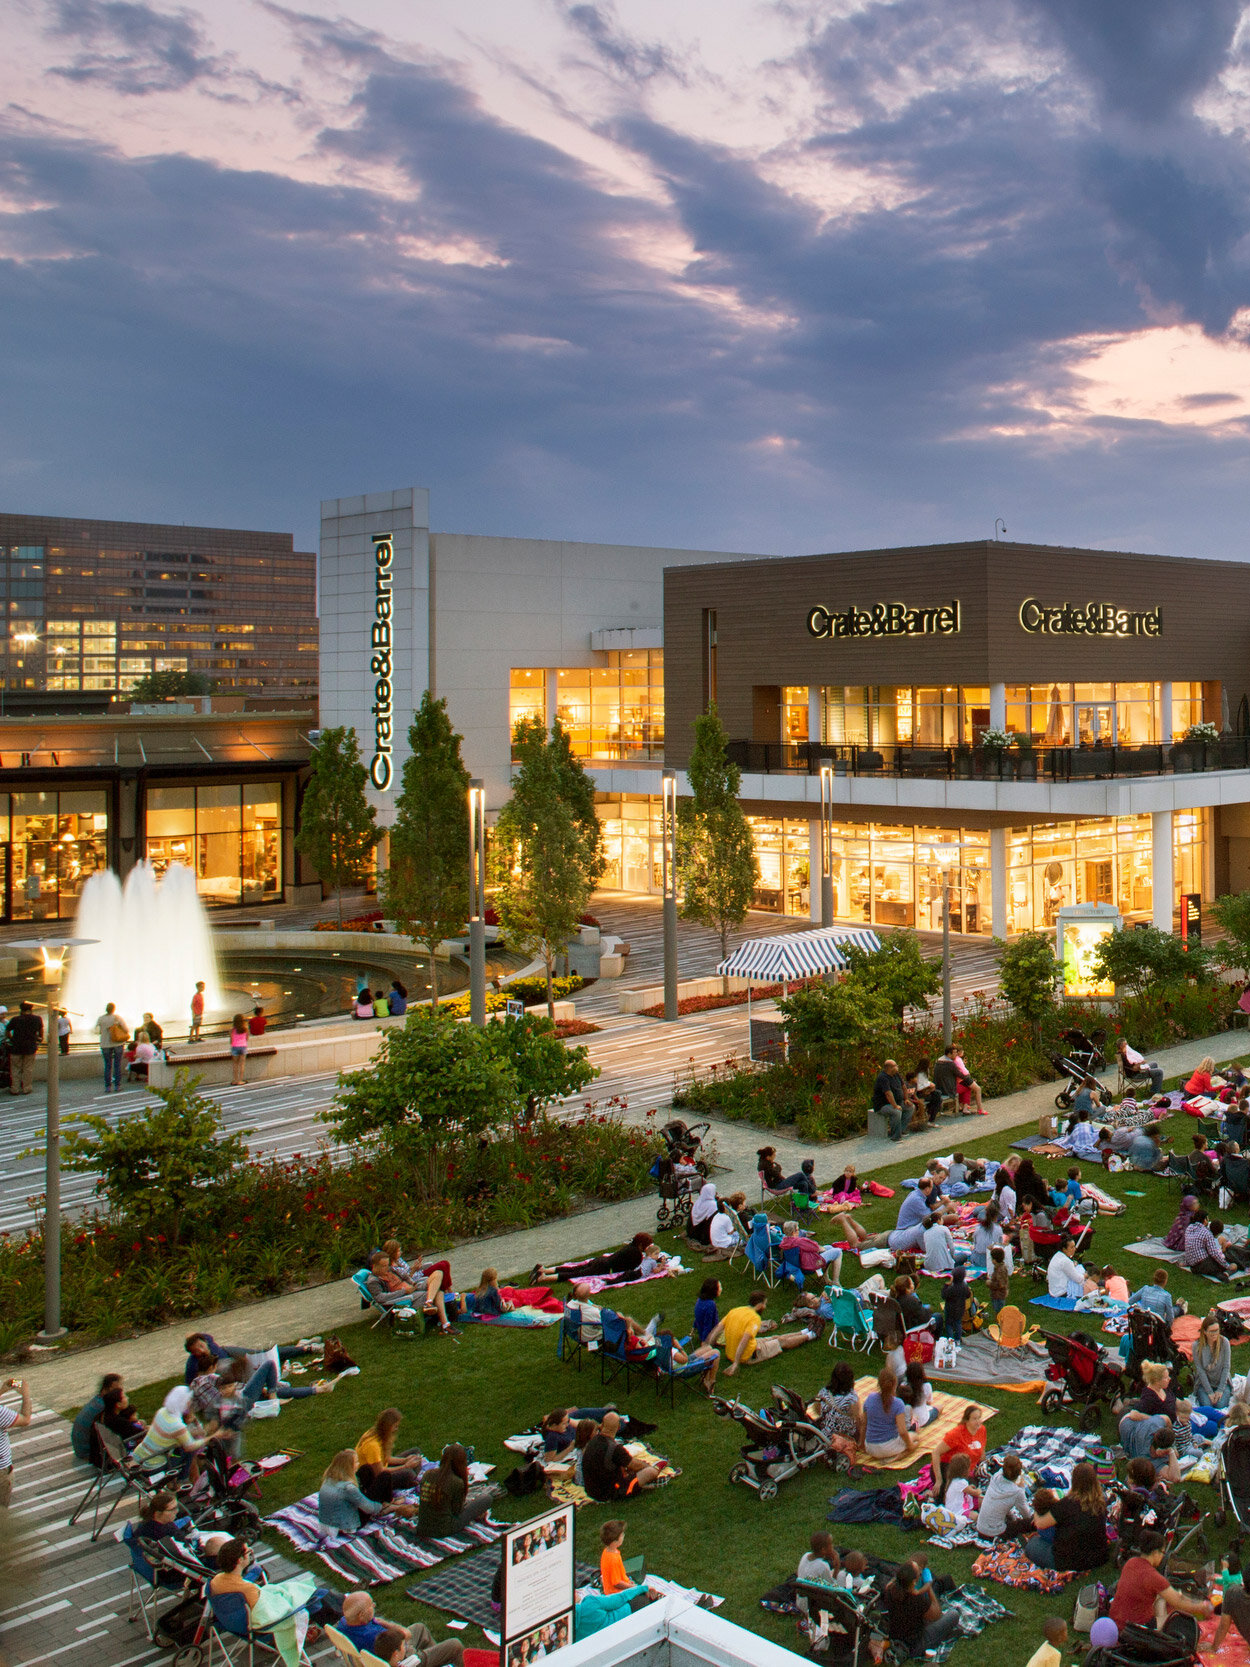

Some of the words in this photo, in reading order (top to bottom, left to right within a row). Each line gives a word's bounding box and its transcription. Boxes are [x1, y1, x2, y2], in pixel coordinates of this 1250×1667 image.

[807, 600, 960, 638] Crate&Barrel
[1020, 598, 1163, 637] Crate&Barrel
[371, 533, 393, 791] Crate&Barrel
[0, 752, 60, 767] RN
